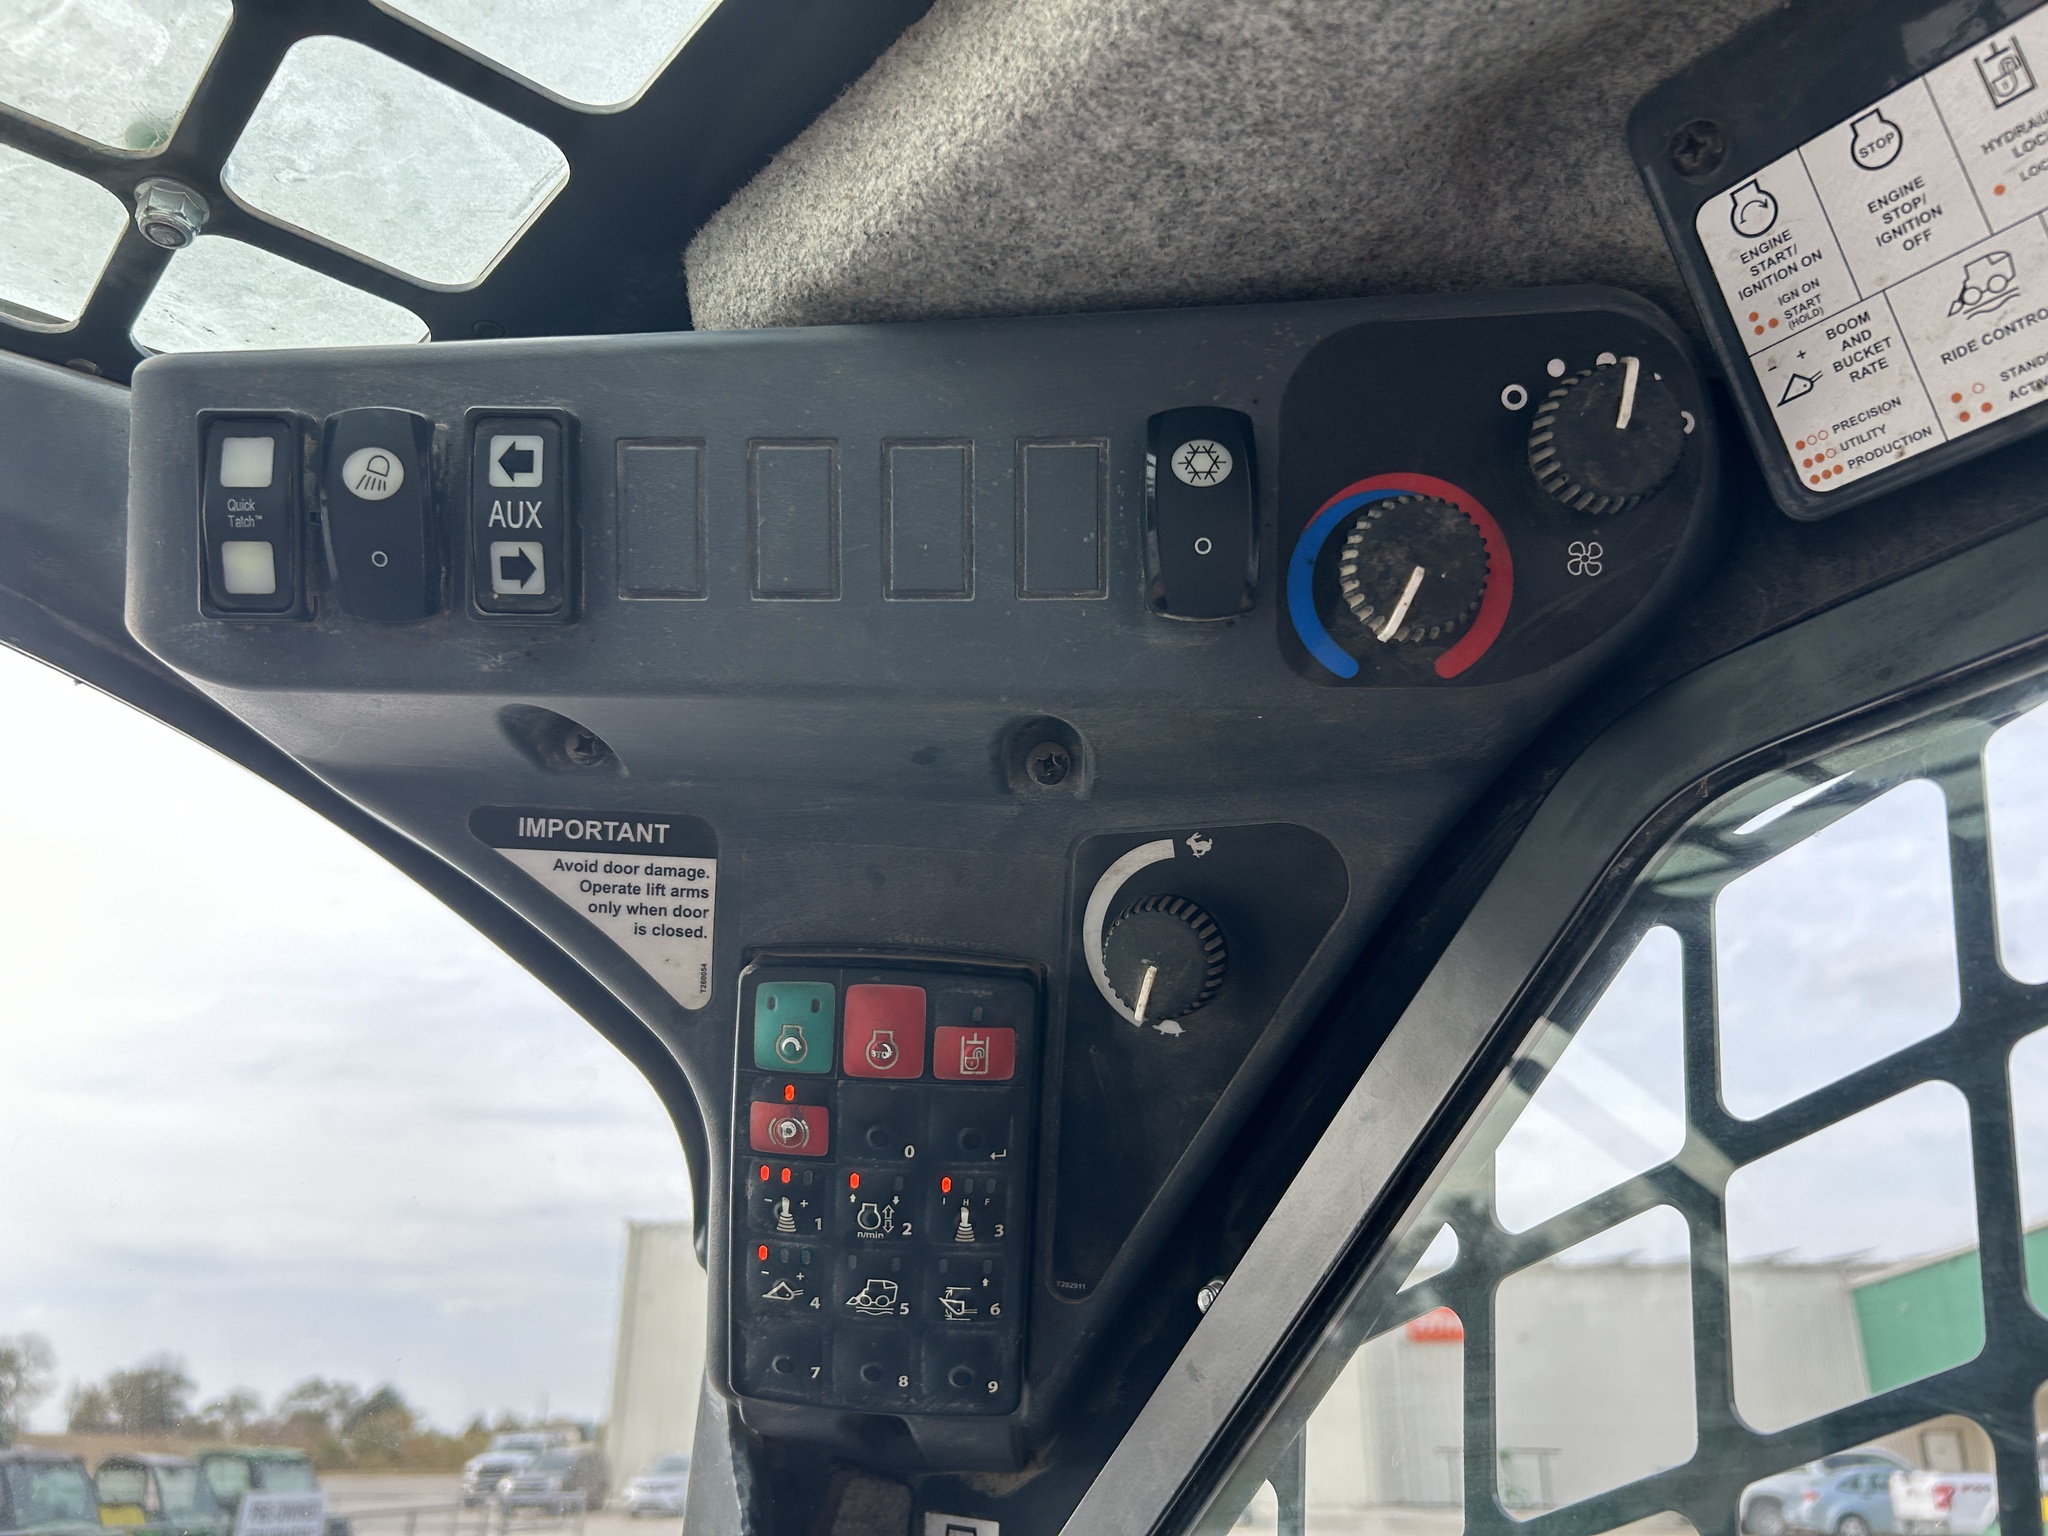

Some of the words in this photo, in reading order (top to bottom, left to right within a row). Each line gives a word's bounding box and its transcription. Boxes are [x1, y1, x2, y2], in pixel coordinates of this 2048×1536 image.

[1859, 132, 1895, 158] STOP
[1867, 176, 1926, 214] ENGINE
[1882, 192, 1927, 224] STOP/
[1875, 205, 1943, 247] IGNITION
[1740, 229, 1793, 265] ENGINE
[1903, 228, 1932, 251] OFF
[1750, 243, 1798, 277] START/
[1738, 262, 1799, 301] IGNITION
[1801, 249, 1823, 267] ON
[1777, 288, 1800, 306] IGN
[1801, 278, 1821, 294] ON
[1784, 293, 1822, 320] START
[1788, 306, 1825, 331] (HOLD)
[1825, 311, 1871, 340] BOOM
[1842, 329, 1872, 351] AND
[1940, 339, 1979, 365] RIDE
[1832, 336, 1892, 372] BUCKET
[2000, 351, 2048, 382] STAND
[1849, 357, 1889, 382] RATE
[1831, 396, 1902, 434] PRECISION
[1839, 424, 1887, 452] UTILITY
[1847, 426, 1933, 469] PRODUCTION
[227, 498, 256, 512] Quick
[488, 500, 543, 529] AUX
[518, 817, 670, 844] IMPORTANT
[553, 858, 598, 873] Avoid
[603, 861, 640, 875] door
[644, 863, 710, 881] damage.
[579, 879, 642, 896] Operate
[646, 883, 667, 897] lift
[671, 887, 710, 899] arms
[588, 901, 622, 917] only
[627, 903, 667, 917] when
[673, 904, 710, 919] door
[634, 922, 647, 935] is
[652, 923, 708, 939] closed.
[700, 963, 708, 994] T260054
[962, 1198, 970, 1206] H
[984, 1198, 991, 1206] F
[814, 1217, 823, 1231] 1
[856, 1230, 885, 1240] n/min
[902, 1222, 913, 1236] 2
[994, 1224, 1005, 1238] 3
[809, 1296, 821, 1309] 4
[899, 1302, 910, 1315] 5
[989, 1302, 1001, 1316] 6
[810, 1366, 821, 1379] 7
[898, 1375, 909, 1387] 8
[987, 1380, 999, 1393] 9
